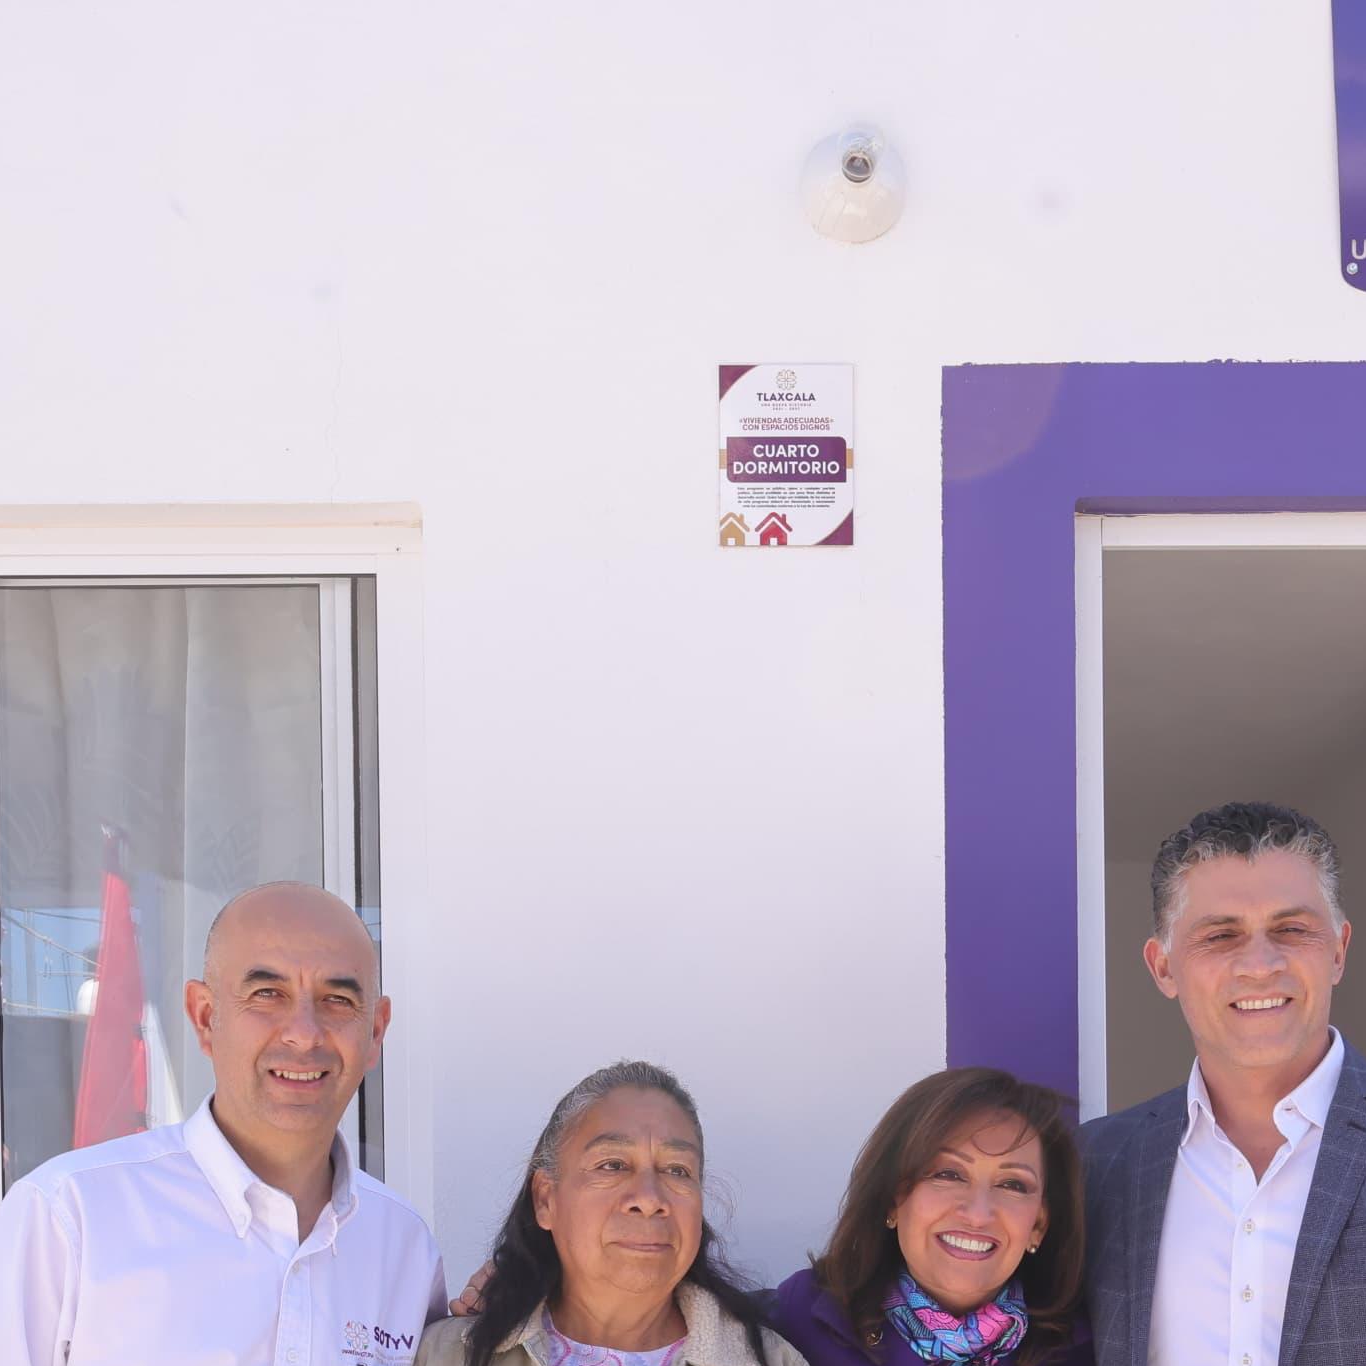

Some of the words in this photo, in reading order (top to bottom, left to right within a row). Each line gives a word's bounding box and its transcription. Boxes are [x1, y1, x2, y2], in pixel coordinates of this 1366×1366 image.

[756, 392, 816, 402] TLAXCALA
[752, 444, 820, 458] CUARTO
[733, 461, 840, 475] DORMITORIO
